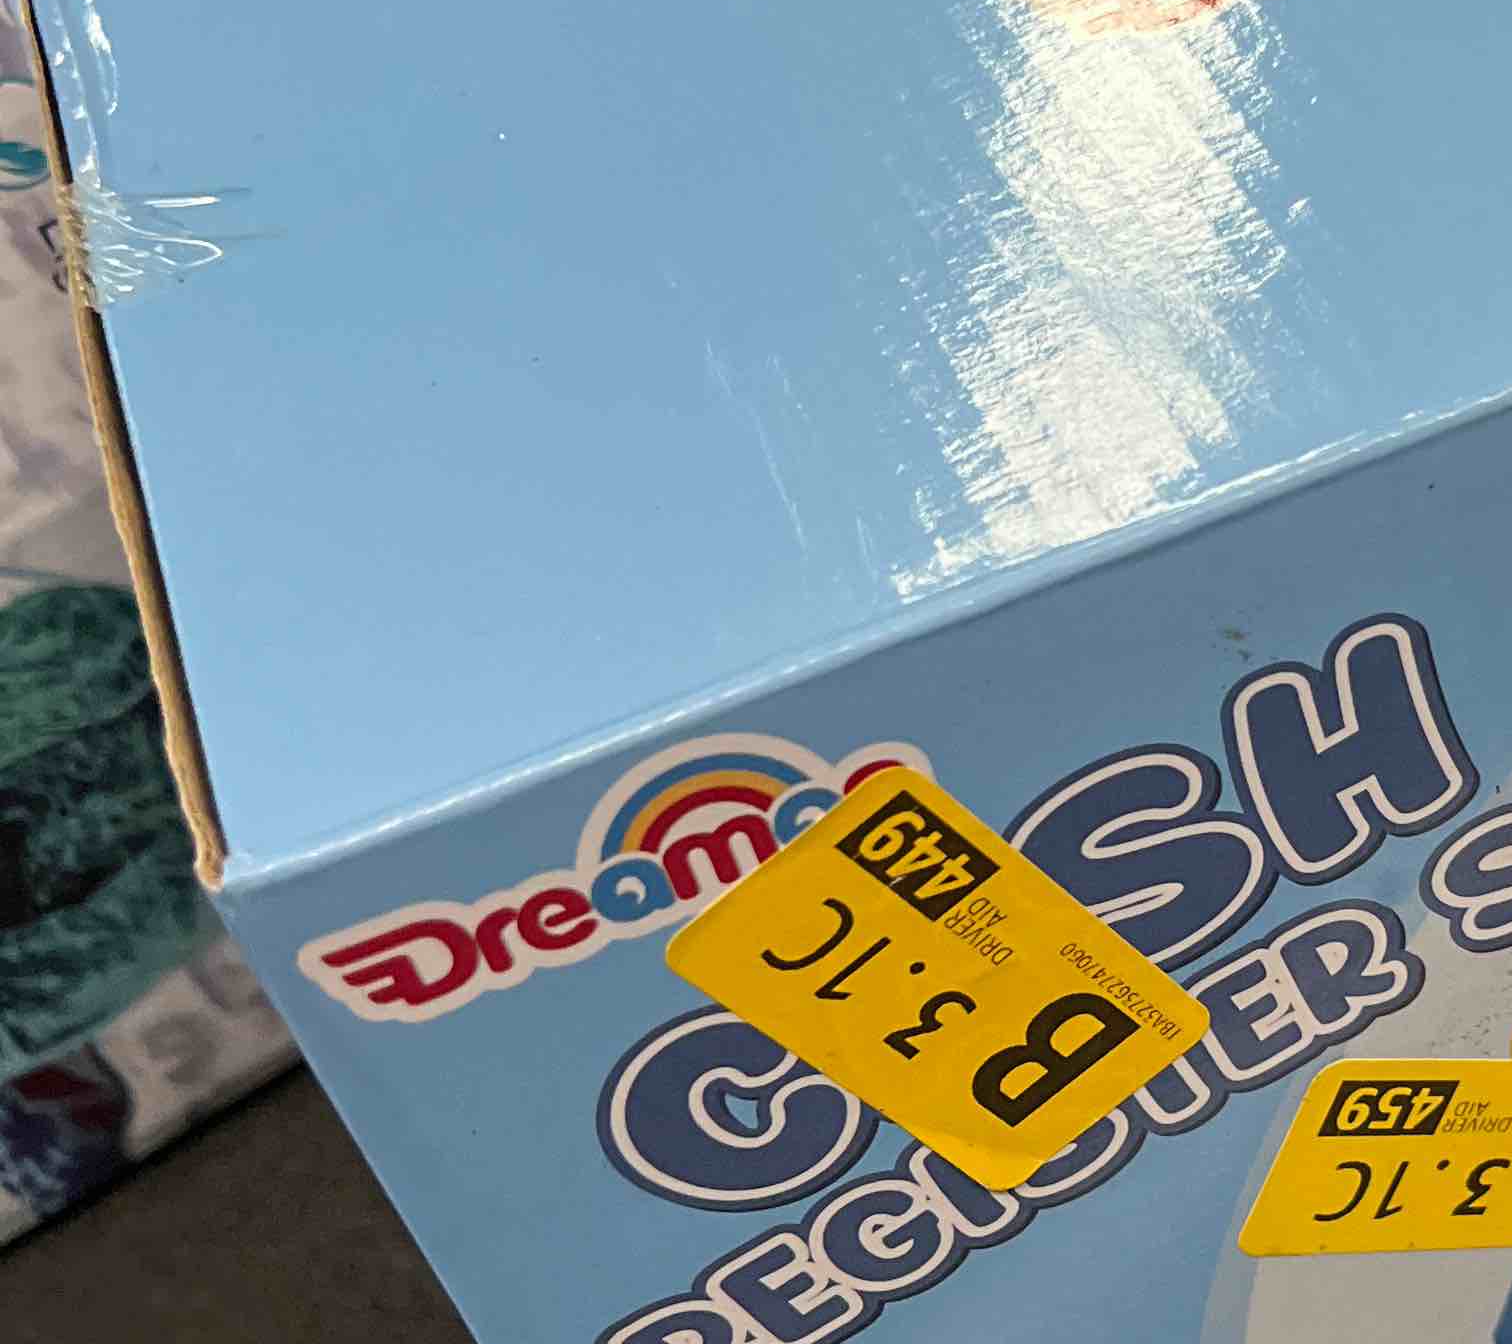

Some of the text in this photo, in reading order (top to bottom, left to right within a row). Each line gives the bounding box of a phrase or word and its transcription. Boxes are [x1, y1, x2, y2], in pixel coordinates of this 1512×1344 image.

[858, 810, 976, 900] 449
[598, 612, 1480, 1212] CSH
[967, 896, 1008, 926] AID
[943, 908, 1016, 967] DRIVER
[972, 992, 1141, 1127] B
[1336, 1087, 1445, 1131] 459
[1443, 1116, 1512, 1133] DRIVER
[1454, 1101, 1491, 1116] AID
